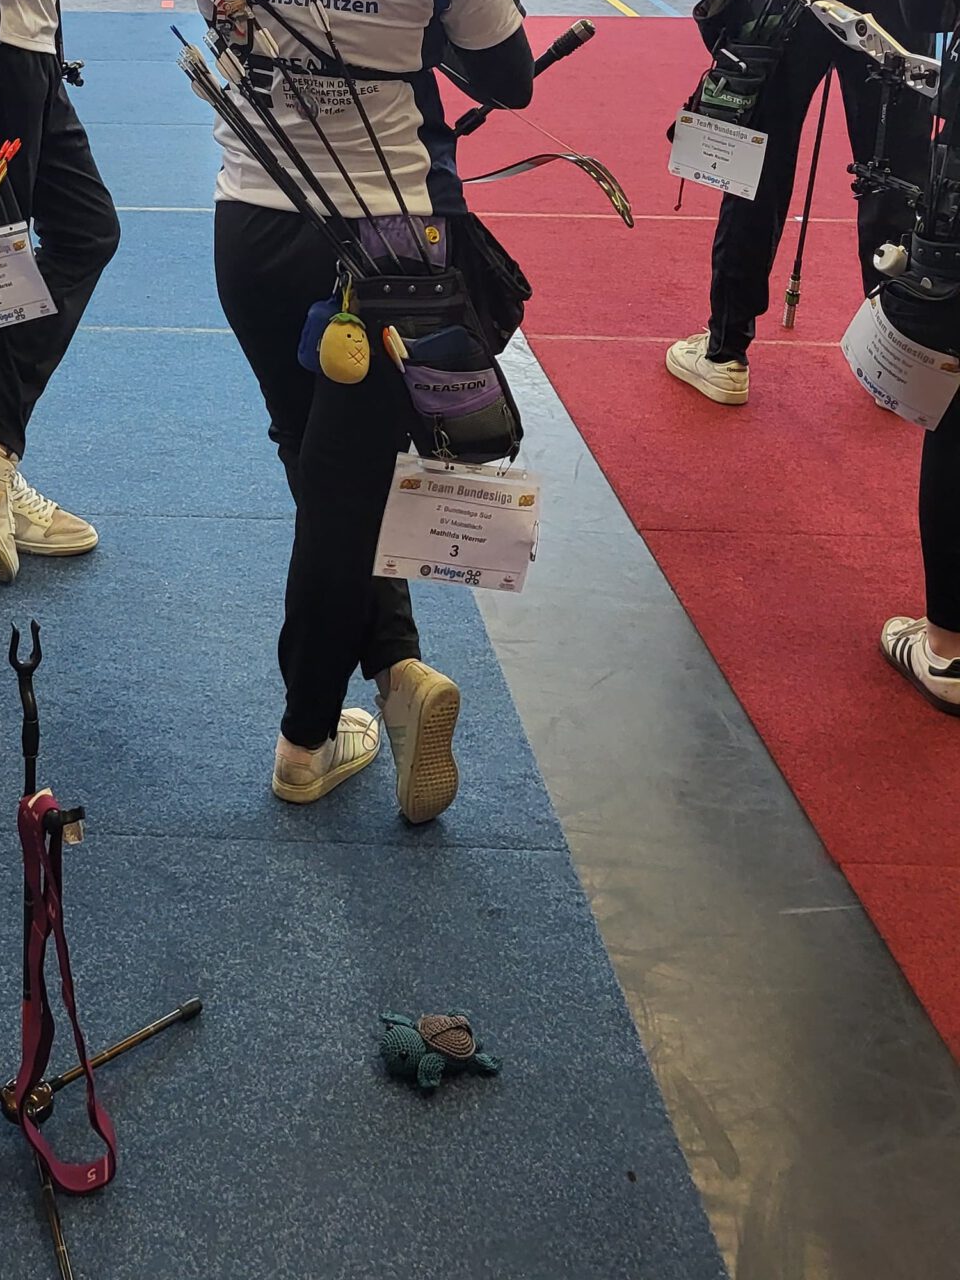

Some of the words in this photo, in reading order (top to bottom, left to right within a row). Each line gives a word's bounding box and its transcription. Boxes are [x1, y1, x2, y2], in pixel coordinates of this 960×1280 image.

[282, 78, 324, 89] EPERTEN
[326, 80, 335, 89] IN
[337, 80, 357, 88] DR
[327, 98, 353, 106] FORS
[719, 93, 752, 105] ASTON
[696, 119, 713, 130] Team
[714, 124, 748, 140] Bundesliga
[711, 162, 717, 170] 4
[874, 309, 888, 333] Team
[887, 329, 935, 365] Bundesliga
[431, 379, 487, 393] EASTON
[426, 480, 454, 494] Team
[456, 484, 513, 505] Bundesliga
[429, 528, 460, 540] Mathilda
[449, 544, 460, 558] 3
[433, 565, 465, 579] krüger
